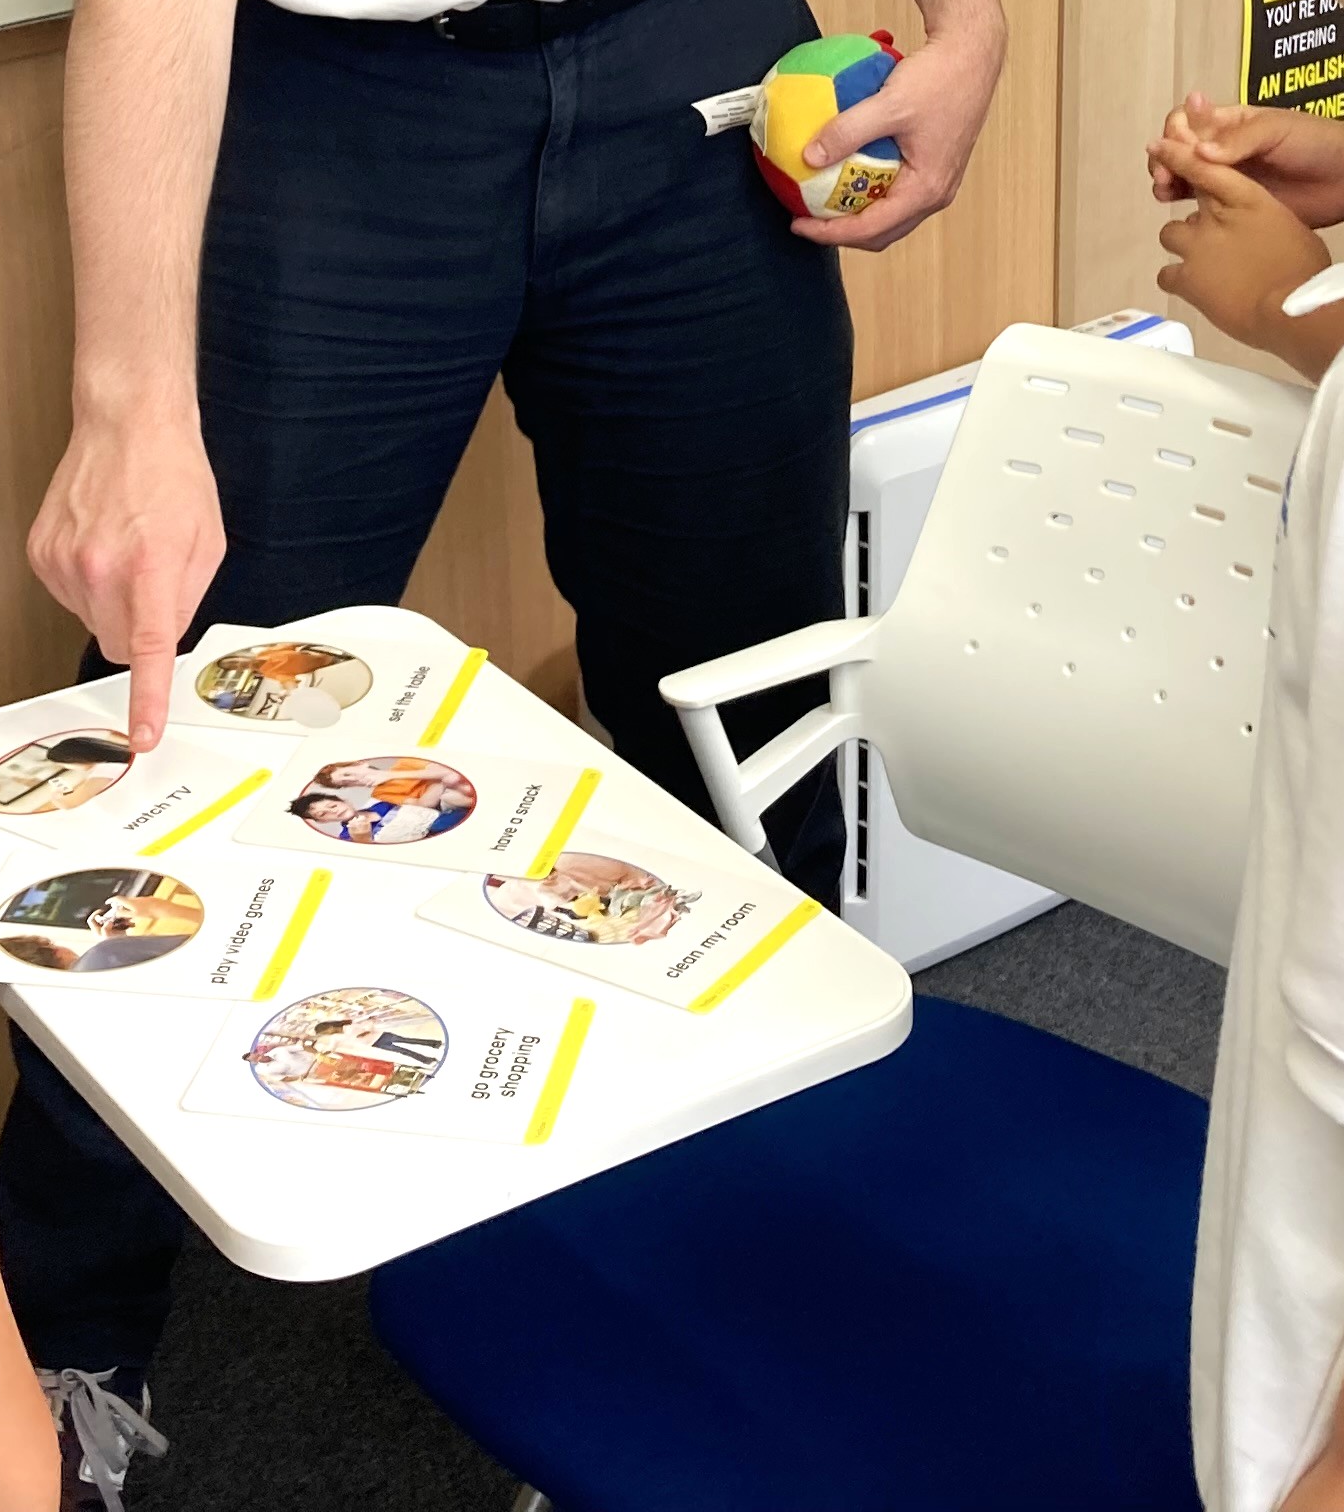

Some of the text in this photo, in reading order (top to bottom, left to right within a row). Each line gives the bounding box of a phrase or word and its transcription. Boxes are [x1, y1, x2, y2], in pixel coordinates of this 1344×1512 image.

[1274, 24, 1337, 59] ENTERING
[1257, 72, 1281, 101] AN
[388, 666, 431, 722] set the table
[123, 785, 192, 831] watch TV
[488, 784, 543, 852] have a snack
[210, 878, 275, 984] play video games
[666, 902, 757, 979] clean my room
[471, 1027, 515, 1100] go grocery
[499, 1035, 541, 1098] shopping
